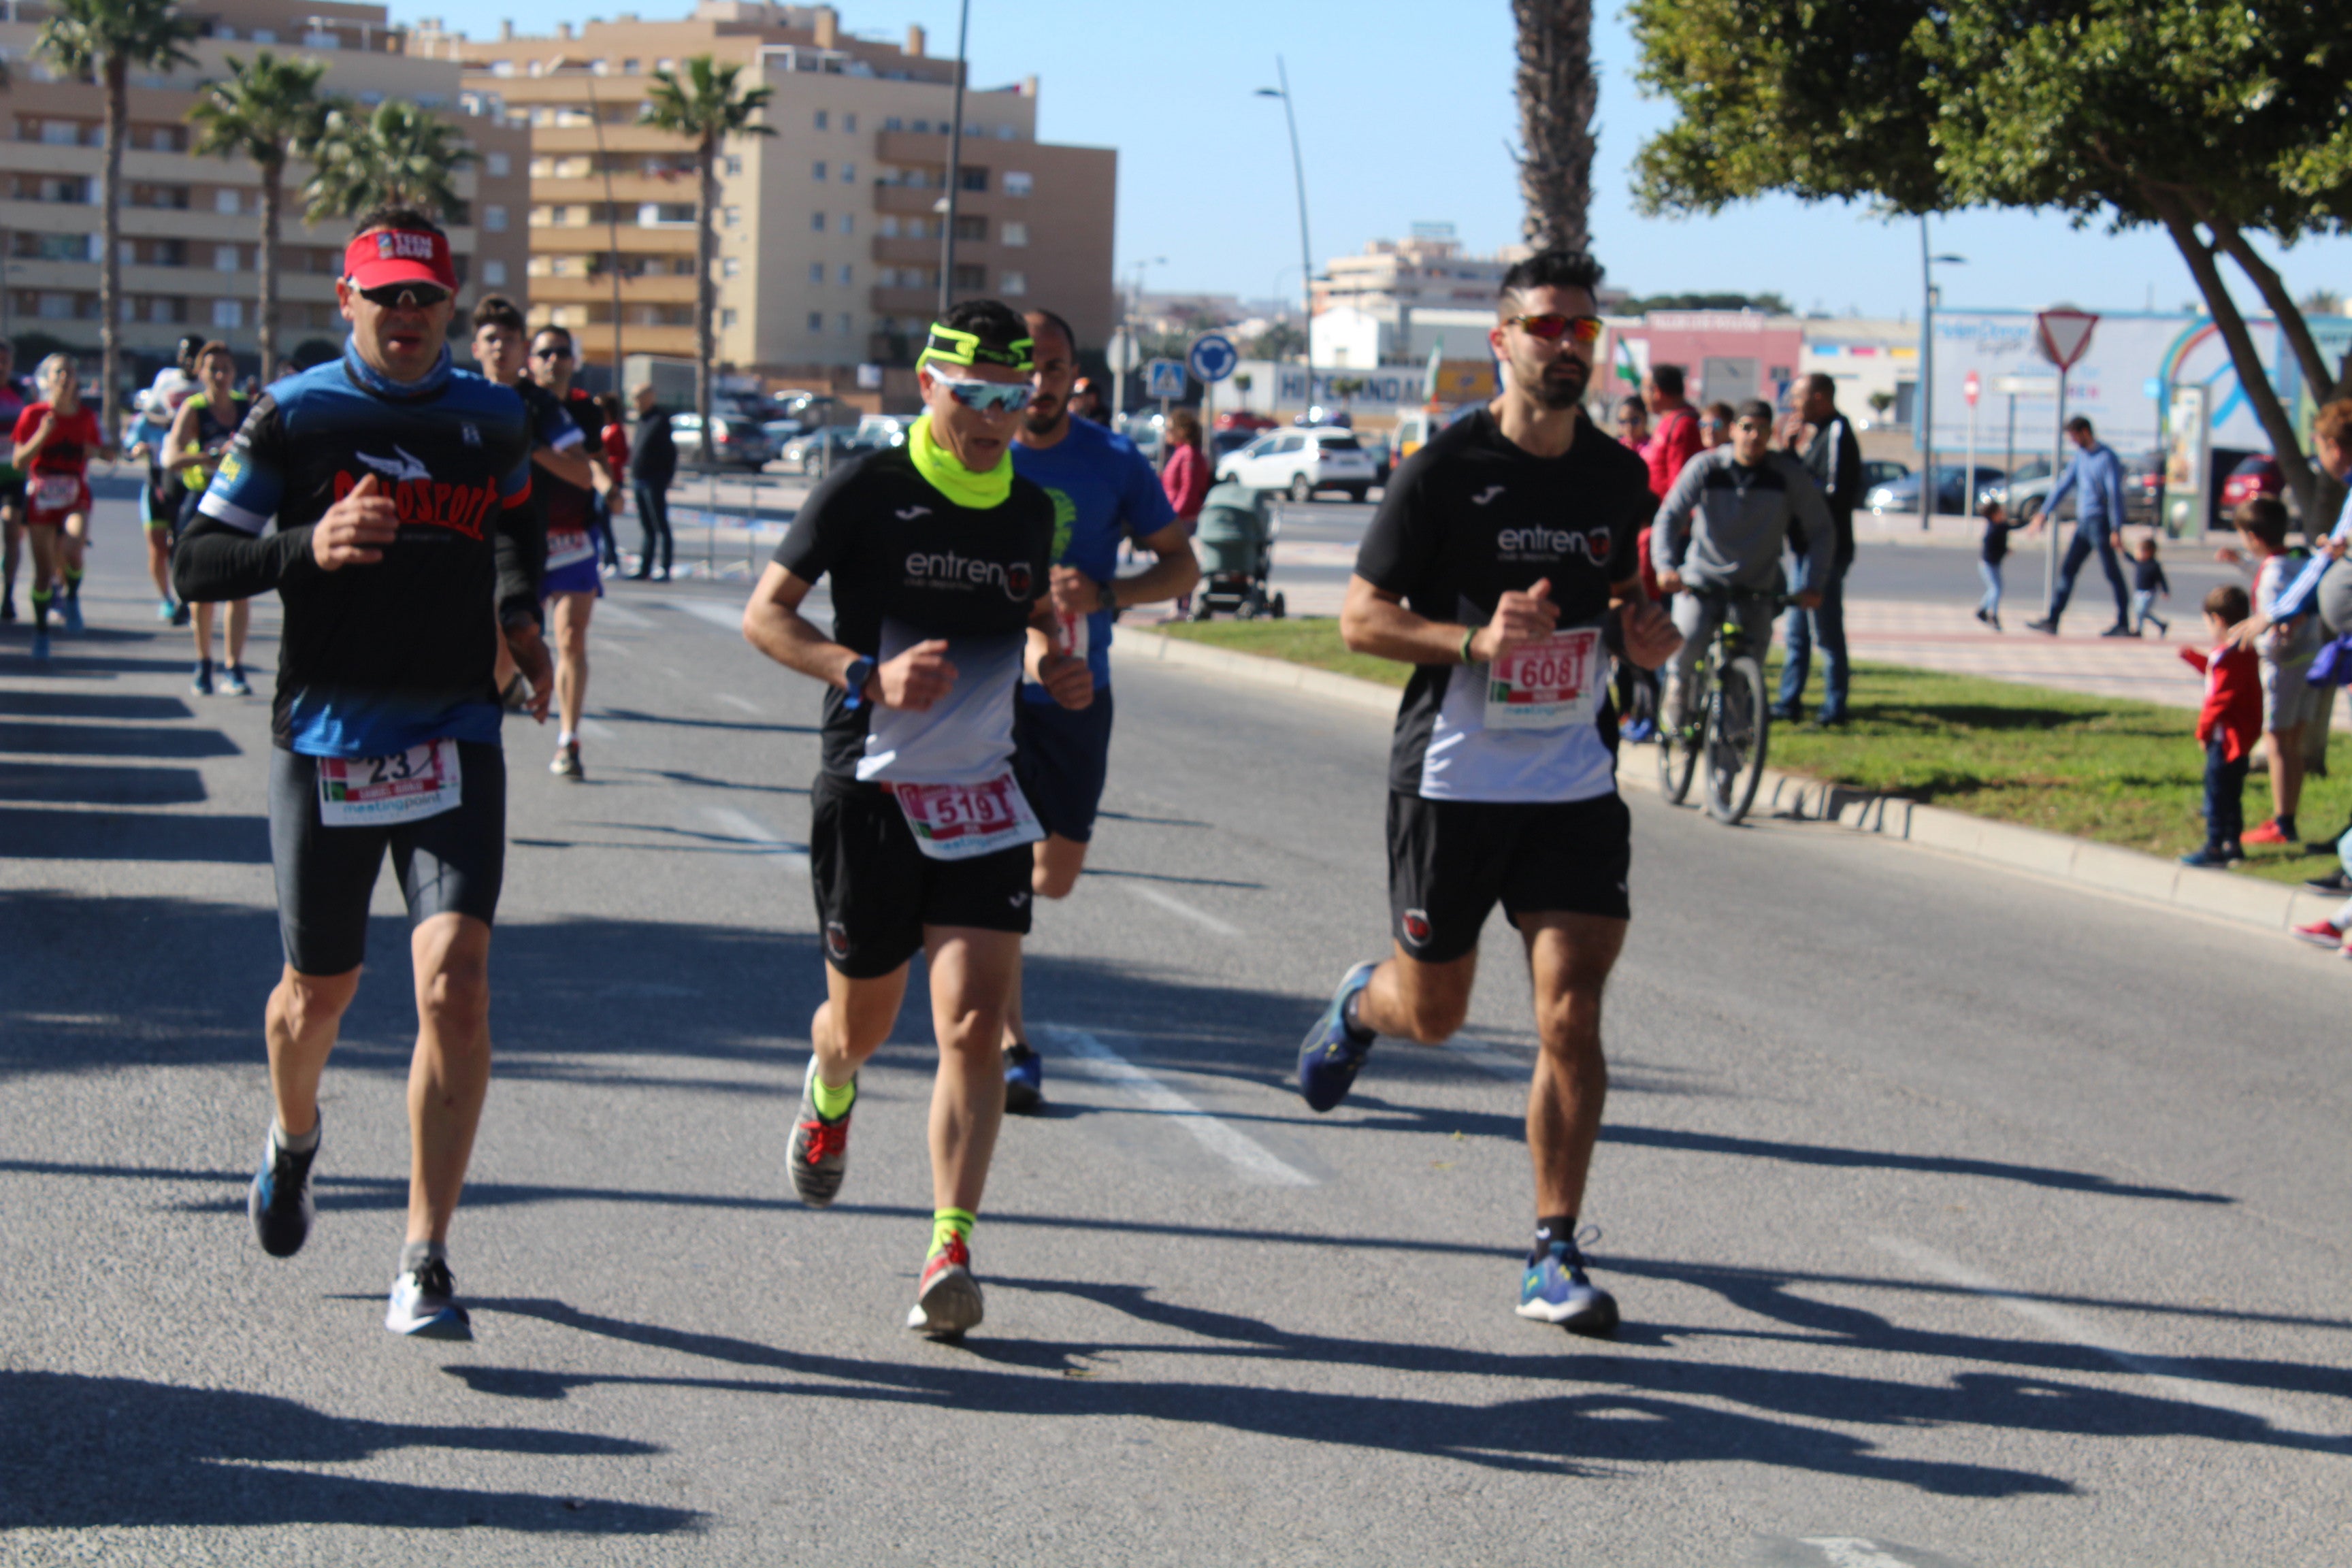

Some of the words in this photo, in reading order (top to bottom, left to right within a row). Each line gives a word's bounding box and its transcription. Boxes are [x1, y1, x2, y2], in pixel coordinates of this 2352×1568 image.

[1520, 655, 1571, 689] 608
[369, 750, 411, 784] 23
[936, 793, 995, 825] 519
